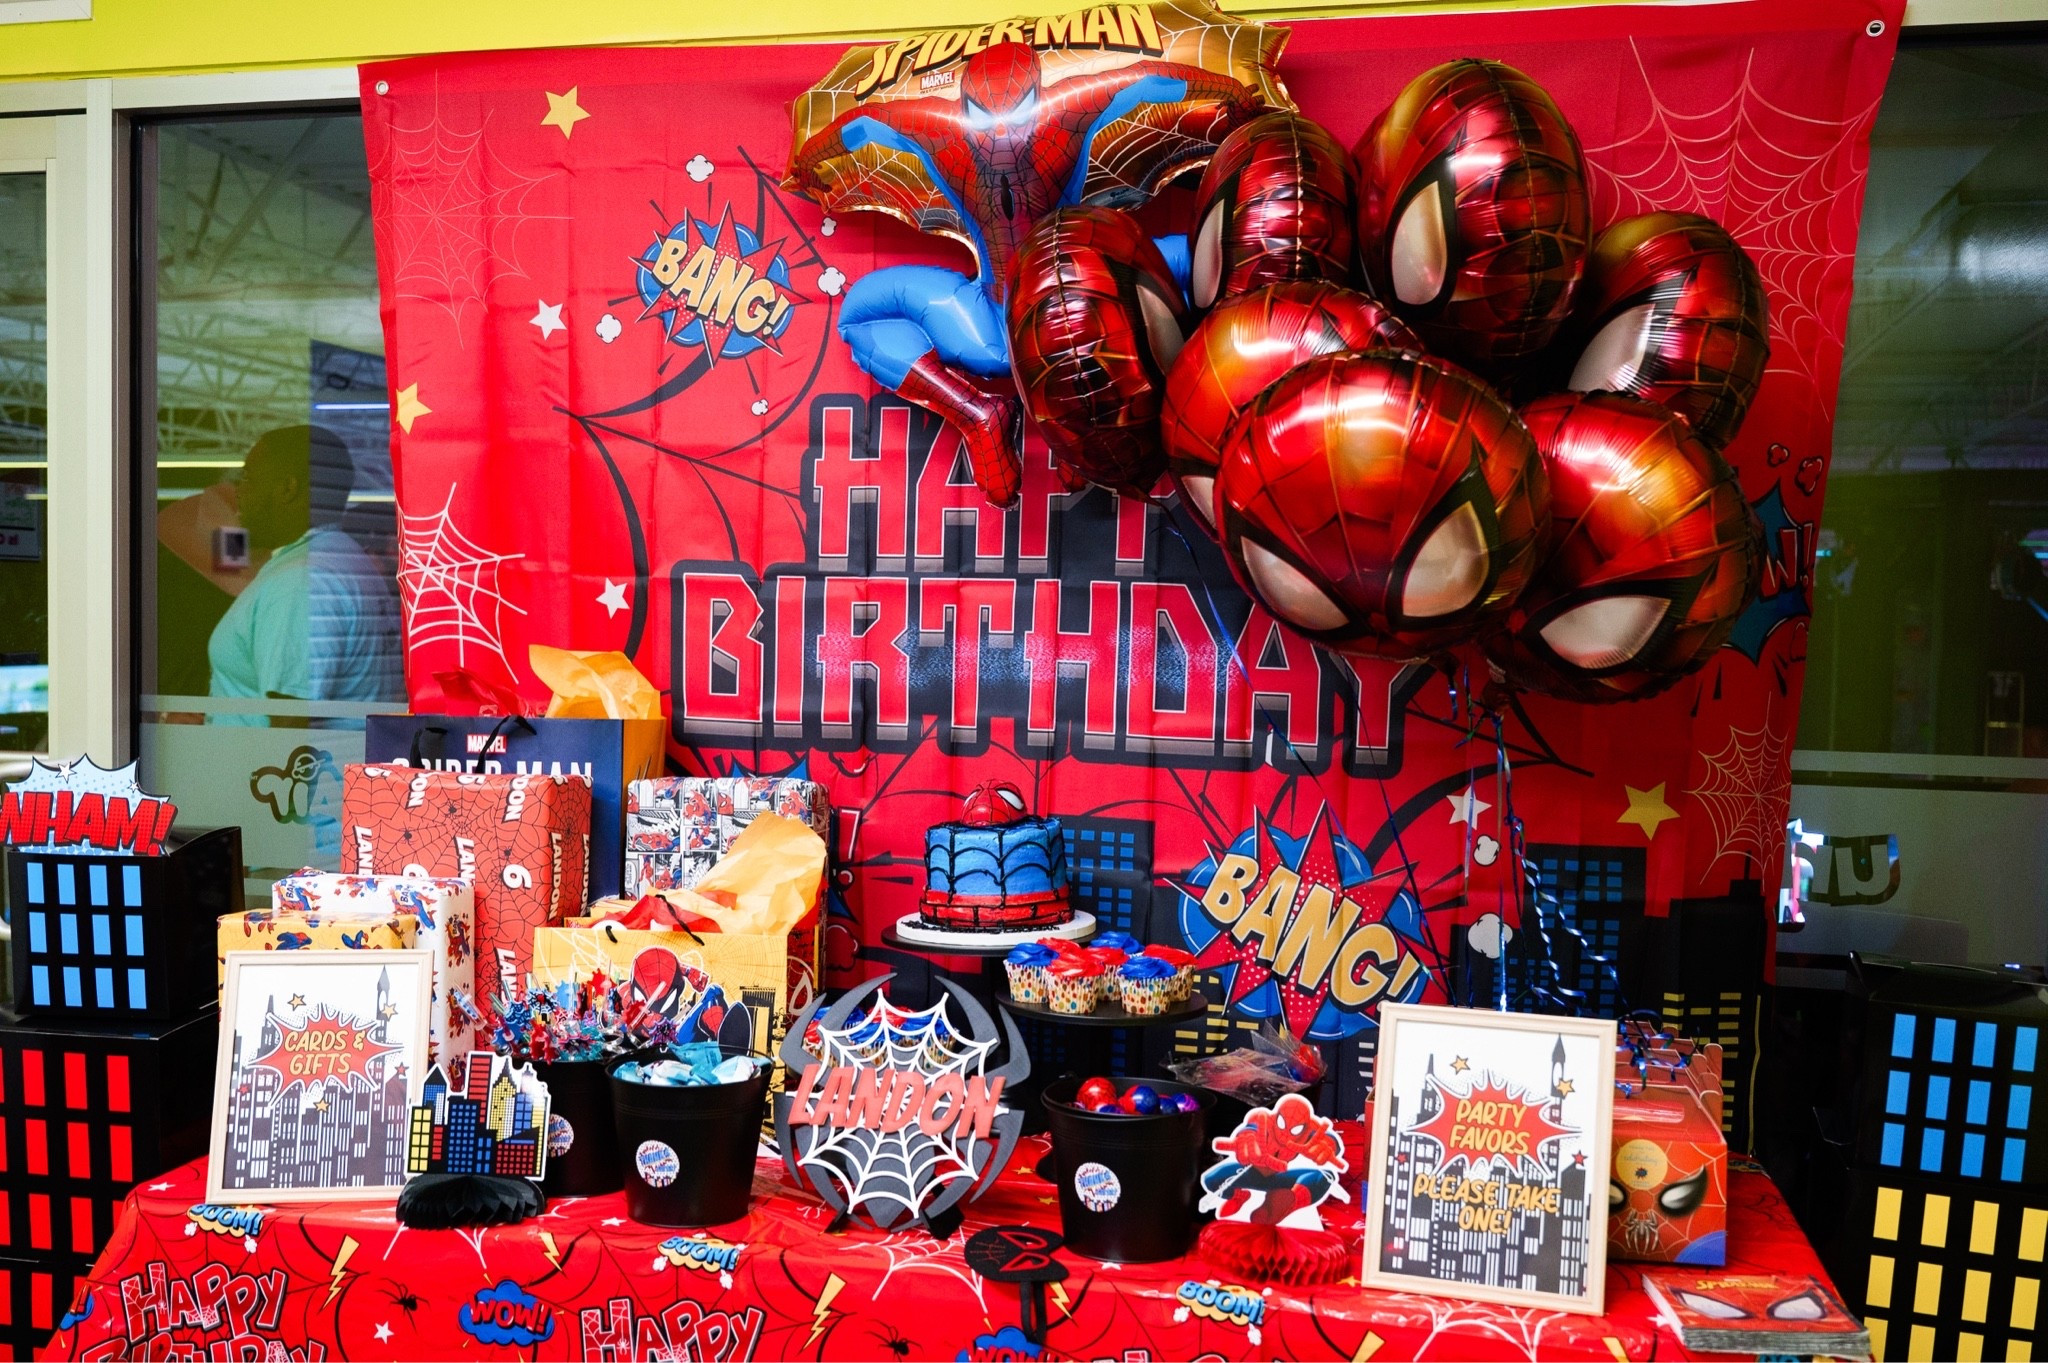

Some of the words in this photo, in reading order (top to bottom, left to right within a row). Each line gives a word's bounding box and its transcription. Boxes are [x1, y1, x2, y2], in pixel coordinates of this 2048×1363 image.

[854, 3, 1165, 99] SPIDER-MAN
[920, 71, 955, 90] MARVEL
[653, 238, 790, 336] BANG!
[681, 570, 1428, 760] BIRTHDAY
[0, 790, 177, 857] WHAM!
[501, 863, 533, 889] 6
[548, 832, 563, 921] LANDON
[580, 833, 591, 917] LANDON
[1201, 852, 1420, 1009] BANG!
[284, 1030, 349, 1052] CARDS
[352, 1030, 366, 1051] &
[289, 1052, 352, 1075] GIFTS
[788, 1063, 1006, 1139] LANDON
[1455, 1099, 1527, 1128] PARTY
[1449, 1125, 1530, 1154] FAVORS
[1413, 1172, 1500, 1206] PLEASE
[1505, 1183, 1562, 1213] TAKE
[1458, 1205, 1513, 1235] ONE!
[660, 1236, 738, 1271] BOOM!
[120, 1262, 287, 1342] HAPPY
[469, 1299, 549, 1333] WOW!
[1180, 1280, 1265, 1325] BOOM!
[580, 1297, 764, 1363] HAPPY
